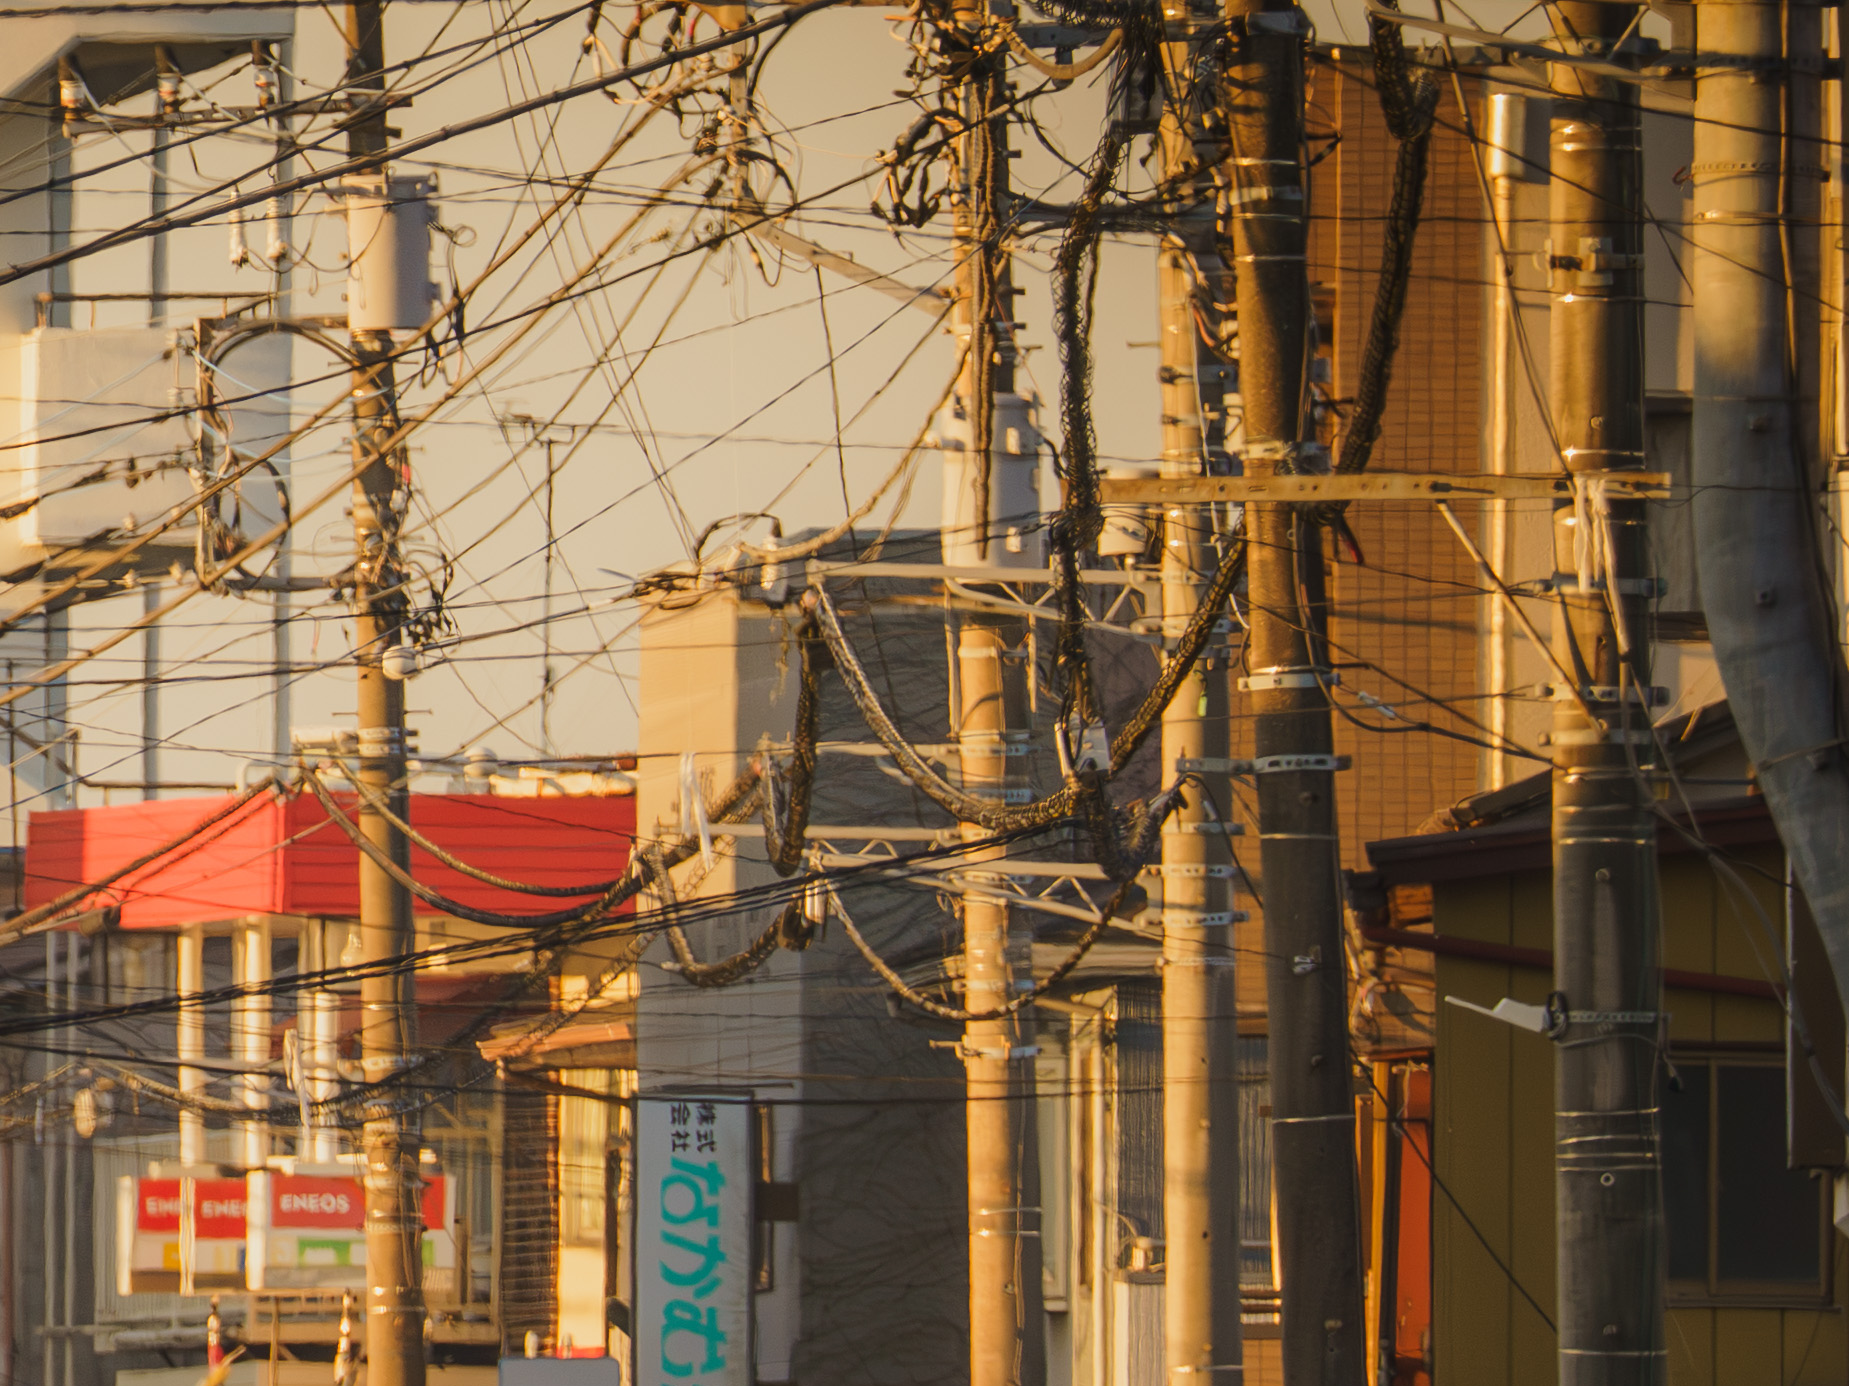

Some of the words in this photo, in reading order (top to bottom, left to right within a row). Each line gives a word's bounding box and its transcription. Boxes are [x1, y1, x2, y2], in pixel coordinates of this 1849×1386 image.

[670, 1102, 690, 1153] 会社
[695, 1103, 718, 1153] 株式
[280, 1192, 350, 1213] ENEOS
